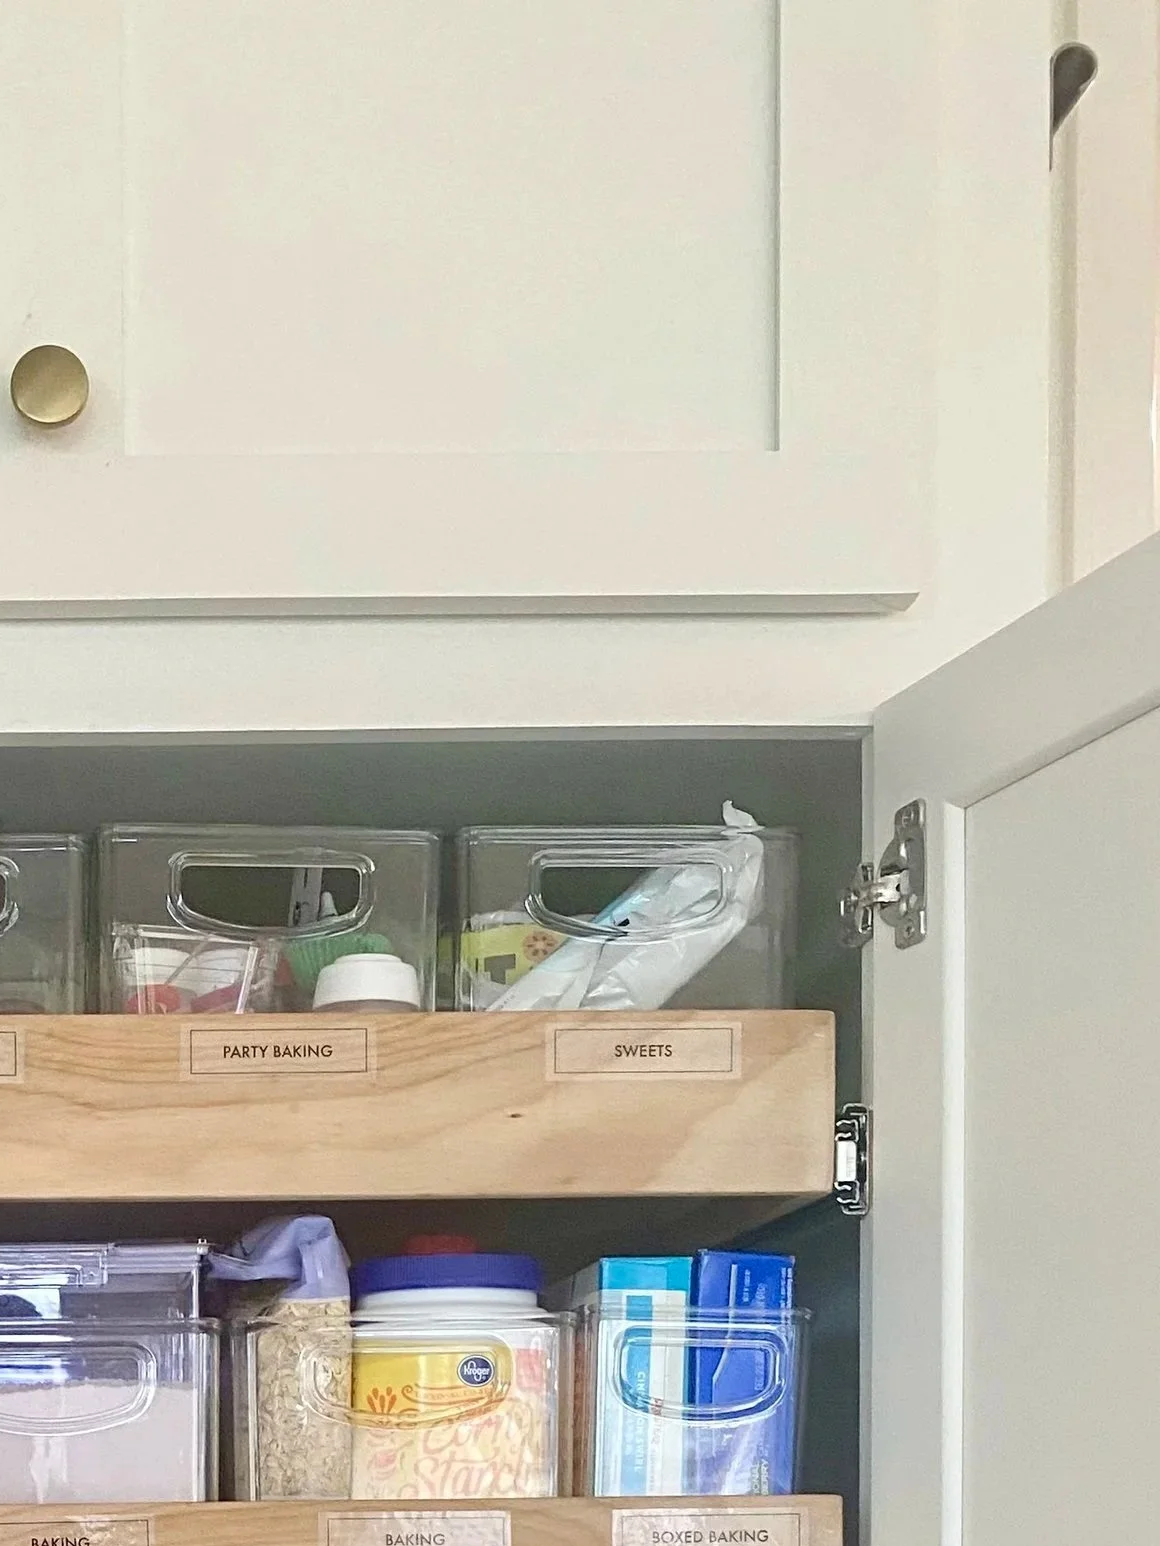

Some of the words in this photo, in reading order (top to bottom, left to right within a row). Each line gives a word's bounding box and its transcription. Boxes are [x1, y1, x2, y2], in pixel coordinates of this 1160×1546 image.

[223, 1045, 268, 1059] PARTY
[273, 1045, 333, 1059] BAKING
[614, 1044, 673, 1058] SWEETS
[463, 1360, 490, 1382] Kroger
[385, 1533, 446, 1546] BAKING
[652, 1531, 704, 1544] BOXED
[709, 1529, 769, 1543] BAKING
